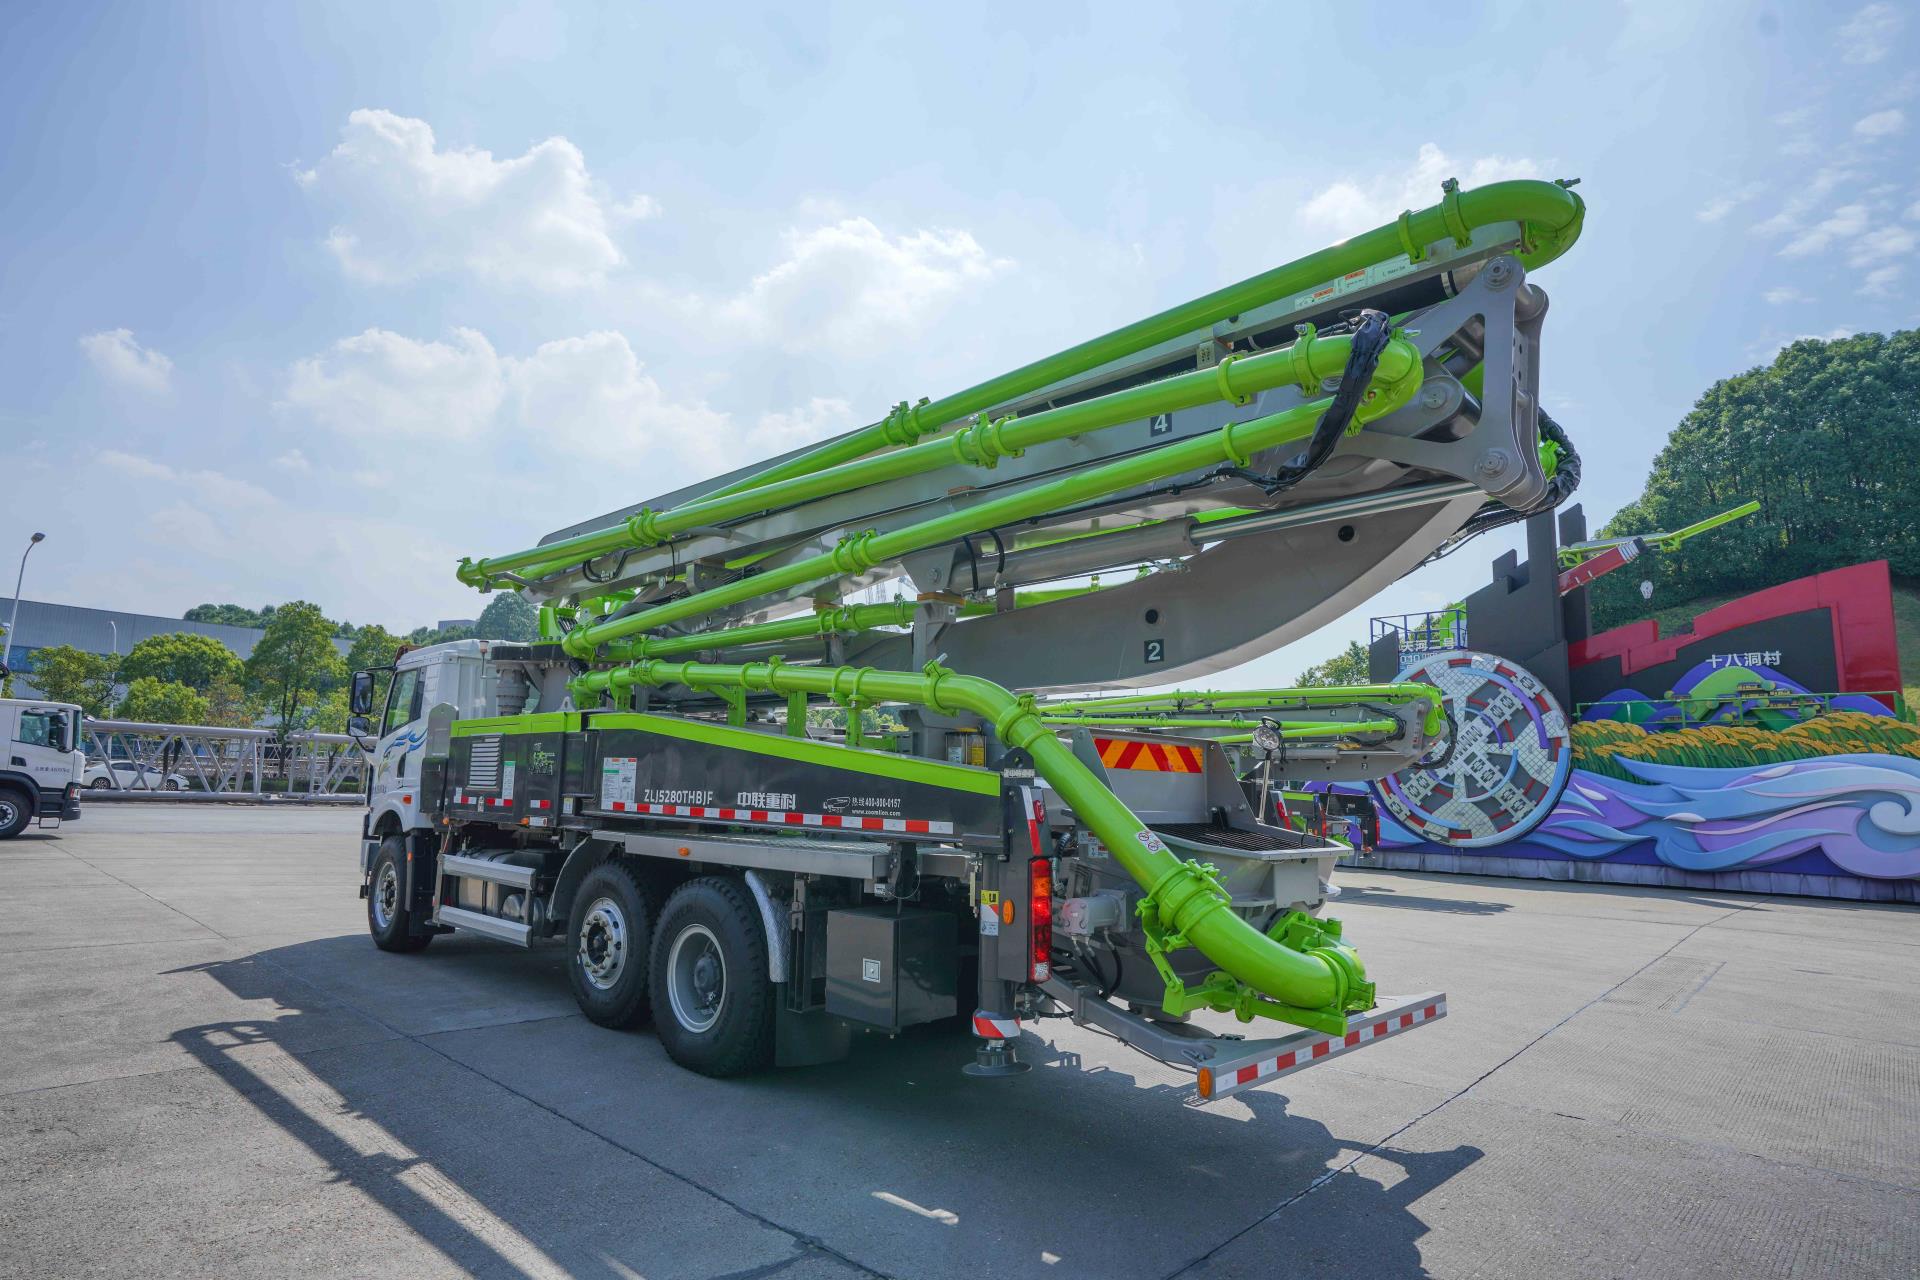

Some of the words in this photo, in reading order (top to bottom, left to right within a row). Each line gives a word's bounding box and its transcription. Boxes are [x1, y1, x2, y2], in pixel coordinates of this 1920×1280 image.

[1154, 414, 1168, 432] 4
[1148, 642, 1160, 661] 2
[1401, 637, 1456, 652] 天河二号
[1705, 650, 1782, 669] 十八洞村
[644, 789, 714, 806] ZLJ5280THBJF
[737, 791, 796, 810] 中联重科
